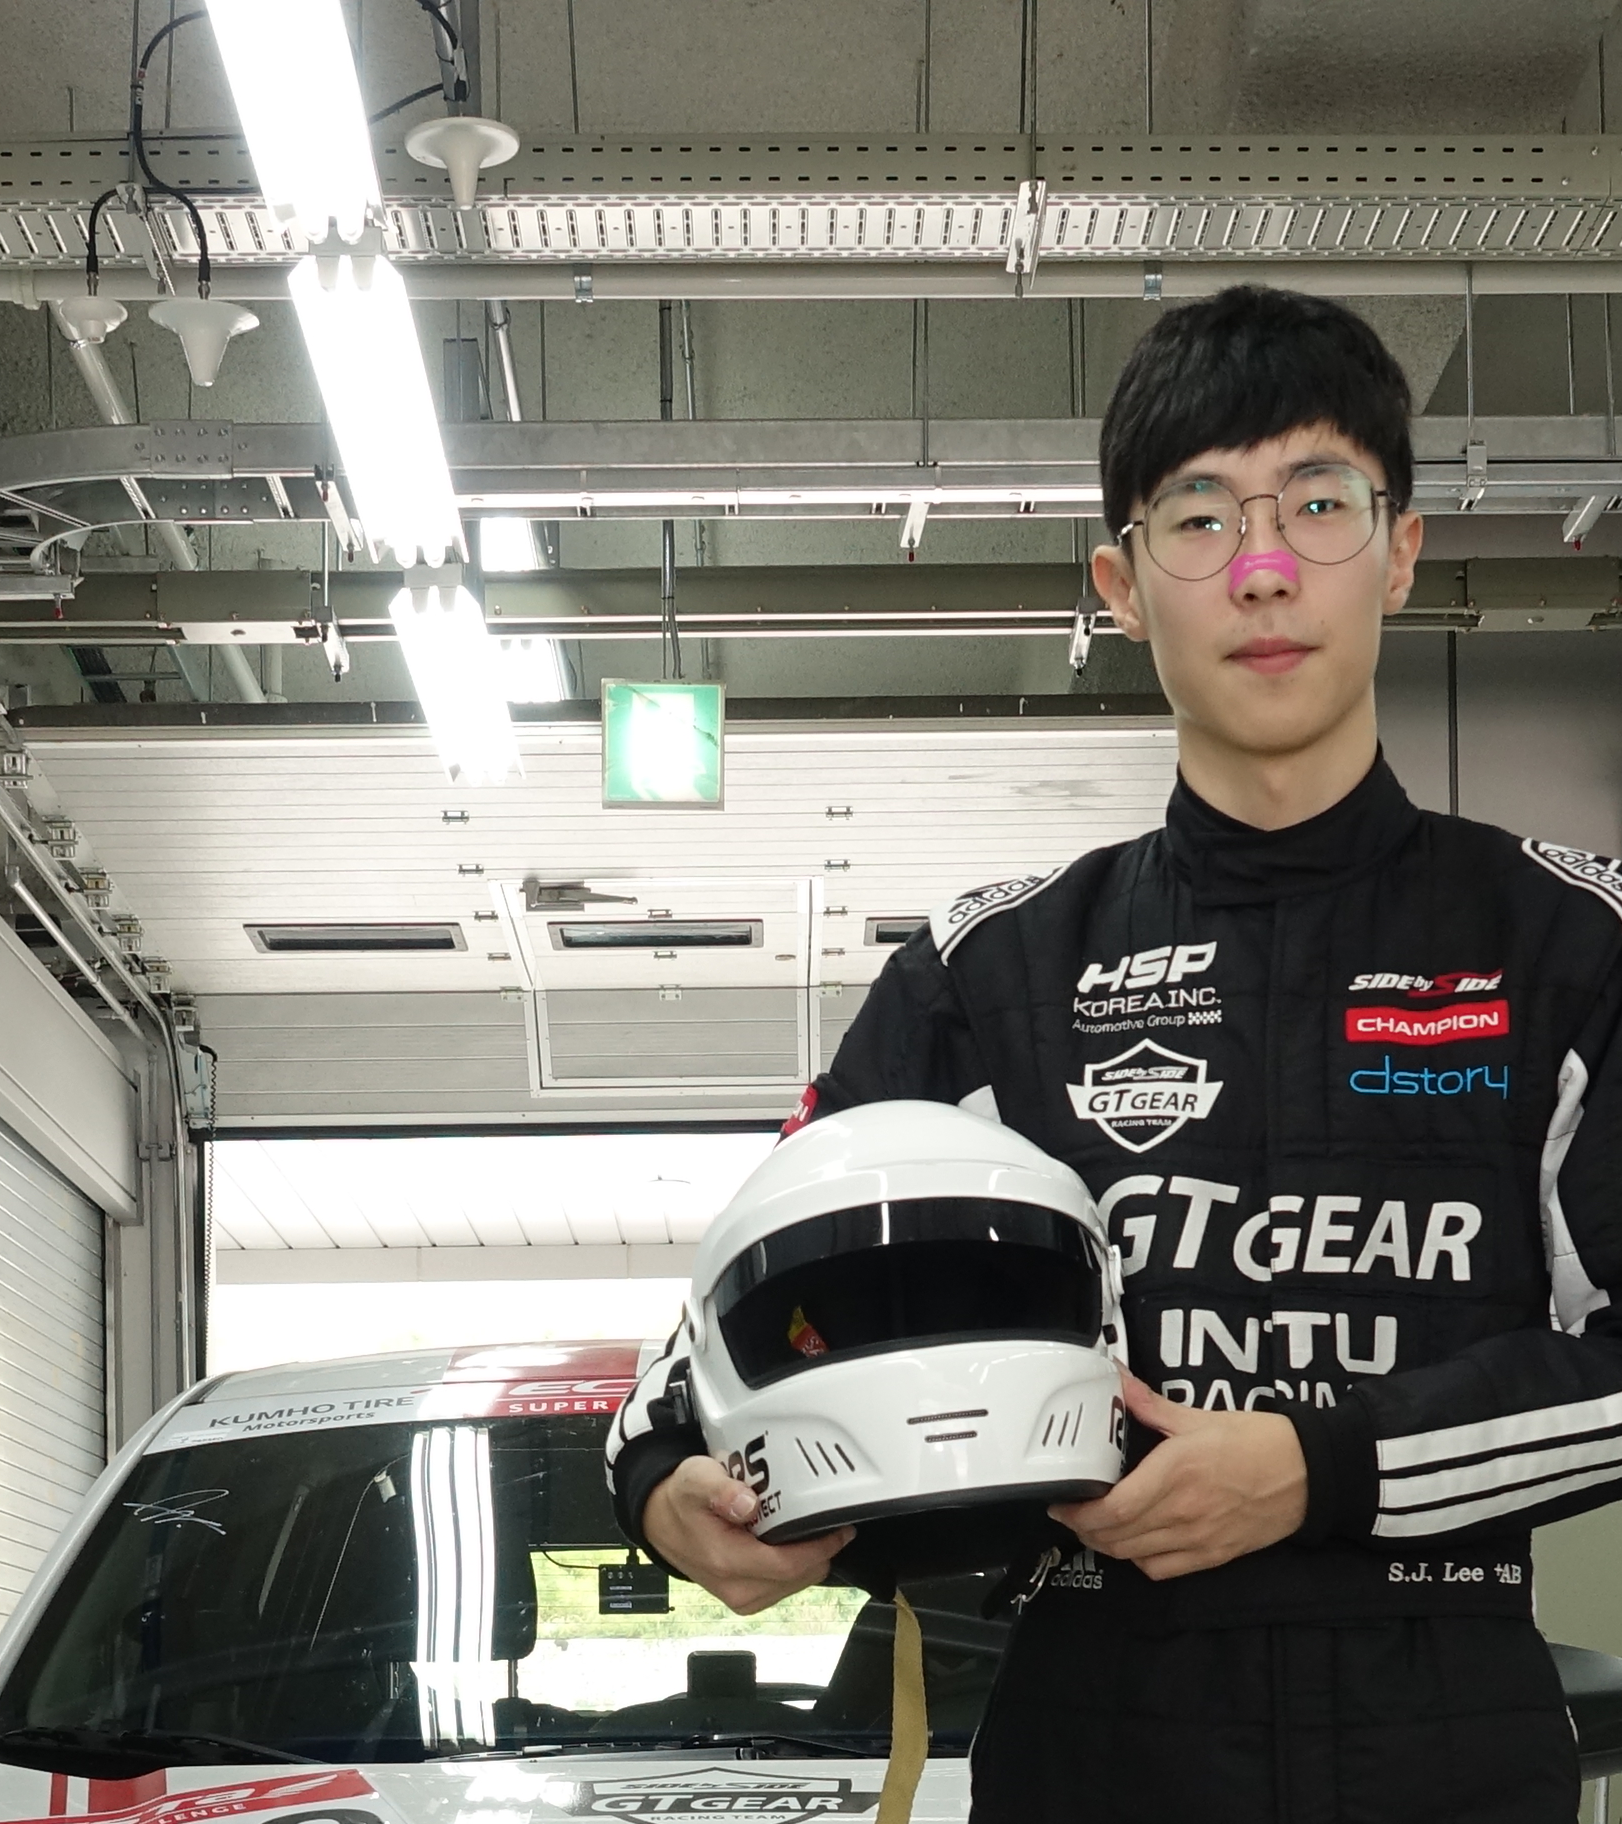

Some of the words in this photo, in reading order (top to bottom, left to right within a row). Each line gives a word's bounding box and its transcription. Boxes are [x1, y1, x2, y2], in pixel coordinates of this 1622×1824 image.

[1077, 941, 1217, 994] HSP
[1073, 992, 1164, 1017] KOREA
[1164, 987, 1222, 1008] INC.
[1072, 1019, 1144, 1034] Automotive
[1147, 1015, 1186, 1028] Group
[1356, 1011, 1499, 1036] CHAMPION
[1349, 1054, 1509, 1100] dstory
[1097, 1173, 1240, 1278] GT
[1232, 1194, 1483, 1282] GEAR
[1159, 1307, 1398, 1375] INTU
[209, 1403, 334, 1428] KUMHO
[342, 1395, 415, 1412] TIRE
[507, 1400, 609, 1414] SUPER
[242, 1411, 376, 1433] Motorsports
[1050, 1571, 1102, 1590] adidas
[1388, 1562, 1433, 1582] S.J.
[1442, 1562, 1485, 1582] Lee
[689, 1795, 844, 1811] GEAR
[650, 1814, 727, 1822] RACING
[733, 1813, 787, 1821] TEAM
